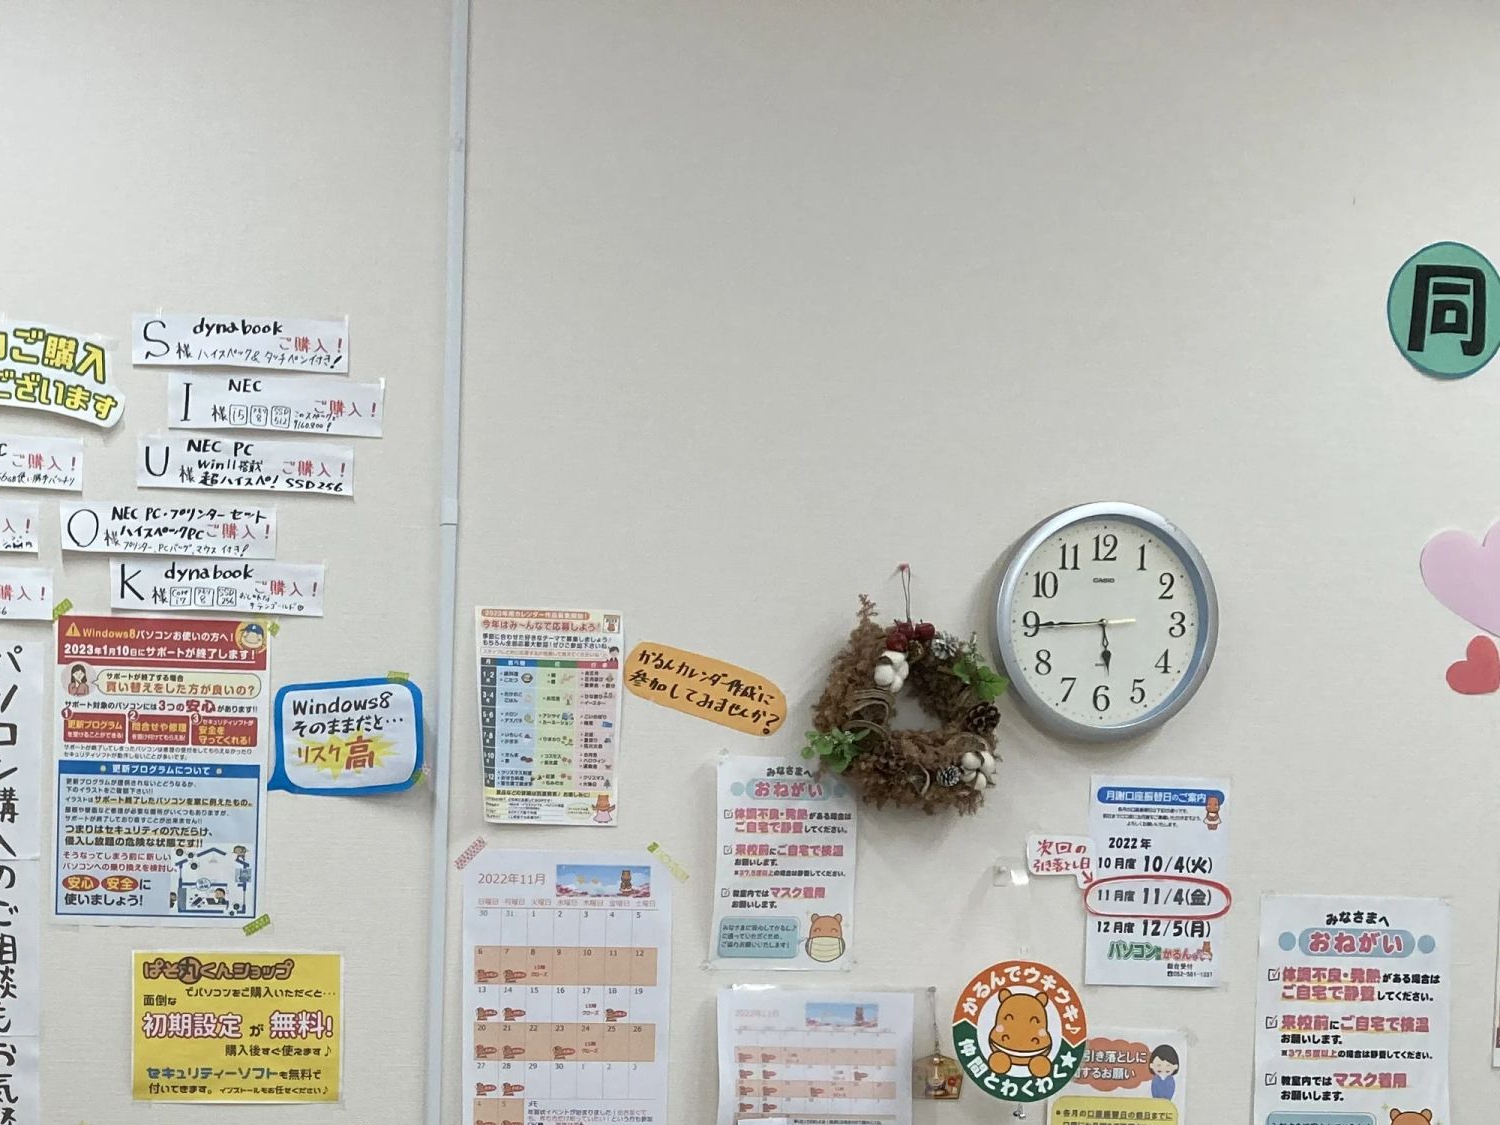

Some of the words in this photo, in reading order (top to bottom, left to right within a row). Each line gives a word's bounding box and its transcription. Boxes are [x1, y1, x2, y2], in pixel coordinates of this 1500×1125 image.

[1407, 264, 1486, 356] 同
[143, 320, 169, 359] S
[192, 318, 282, 337] dynabook
[228, 379, 262, 393] NEC
[145, 446, 169, 477] U
[187, 439, 221, 453] NEC
[233, 442, 254, 456] PC
[1059, 543, 1080, 570] 11
[1092, 534, 1118, 561] 12
[1137, 544, 1147, 571] 1
[120, 564, 144, 600] K
[165, 562, 254, 580] dynabook
[1033, 571, 1058, 598] 10
[1159, 573, 1174, 599] 2
[1023, 611, 1040, 637] 9
[1169, 611, 1186, 637] 3
[64, 644, 255, 661] 2023年1月10日にサポートが終了します!
[1035, 650, 1052, 675] 8
[1155, 649, 1171, 673] 4
[106, 682, 255, 695] 買い替えをした方が良いの?
[1061, 677, 1076, 702] 7
[1093, 685, 1110, 711] 6
[1130, 679, 1145, 704] 5
[293, 692, 393, 717] Windows8
[629, 671, 781, 736] 参加してみませんか?
[766, 767, 813, 777] みなさまへ
[755, 782, 823, 797] おねがい
[1038, 840, 1086, 855] 次回の
[1109, 838, 1151, 849] 2022年
[1033, 857, 1090, 872] 引き落とし日
[478, 874, 546, 885] 2022年11月
[64, 894, 143, 906] 使いましょう!
[1326, 911, 1390, 926] みなさまへ
[1309, 932, 1403, 952] おねがい
[142, 1013, 242, 1038] 初期設定
[250, 1025, 263, 1037] が
[270, 1011, 333, 1038] 無料!
